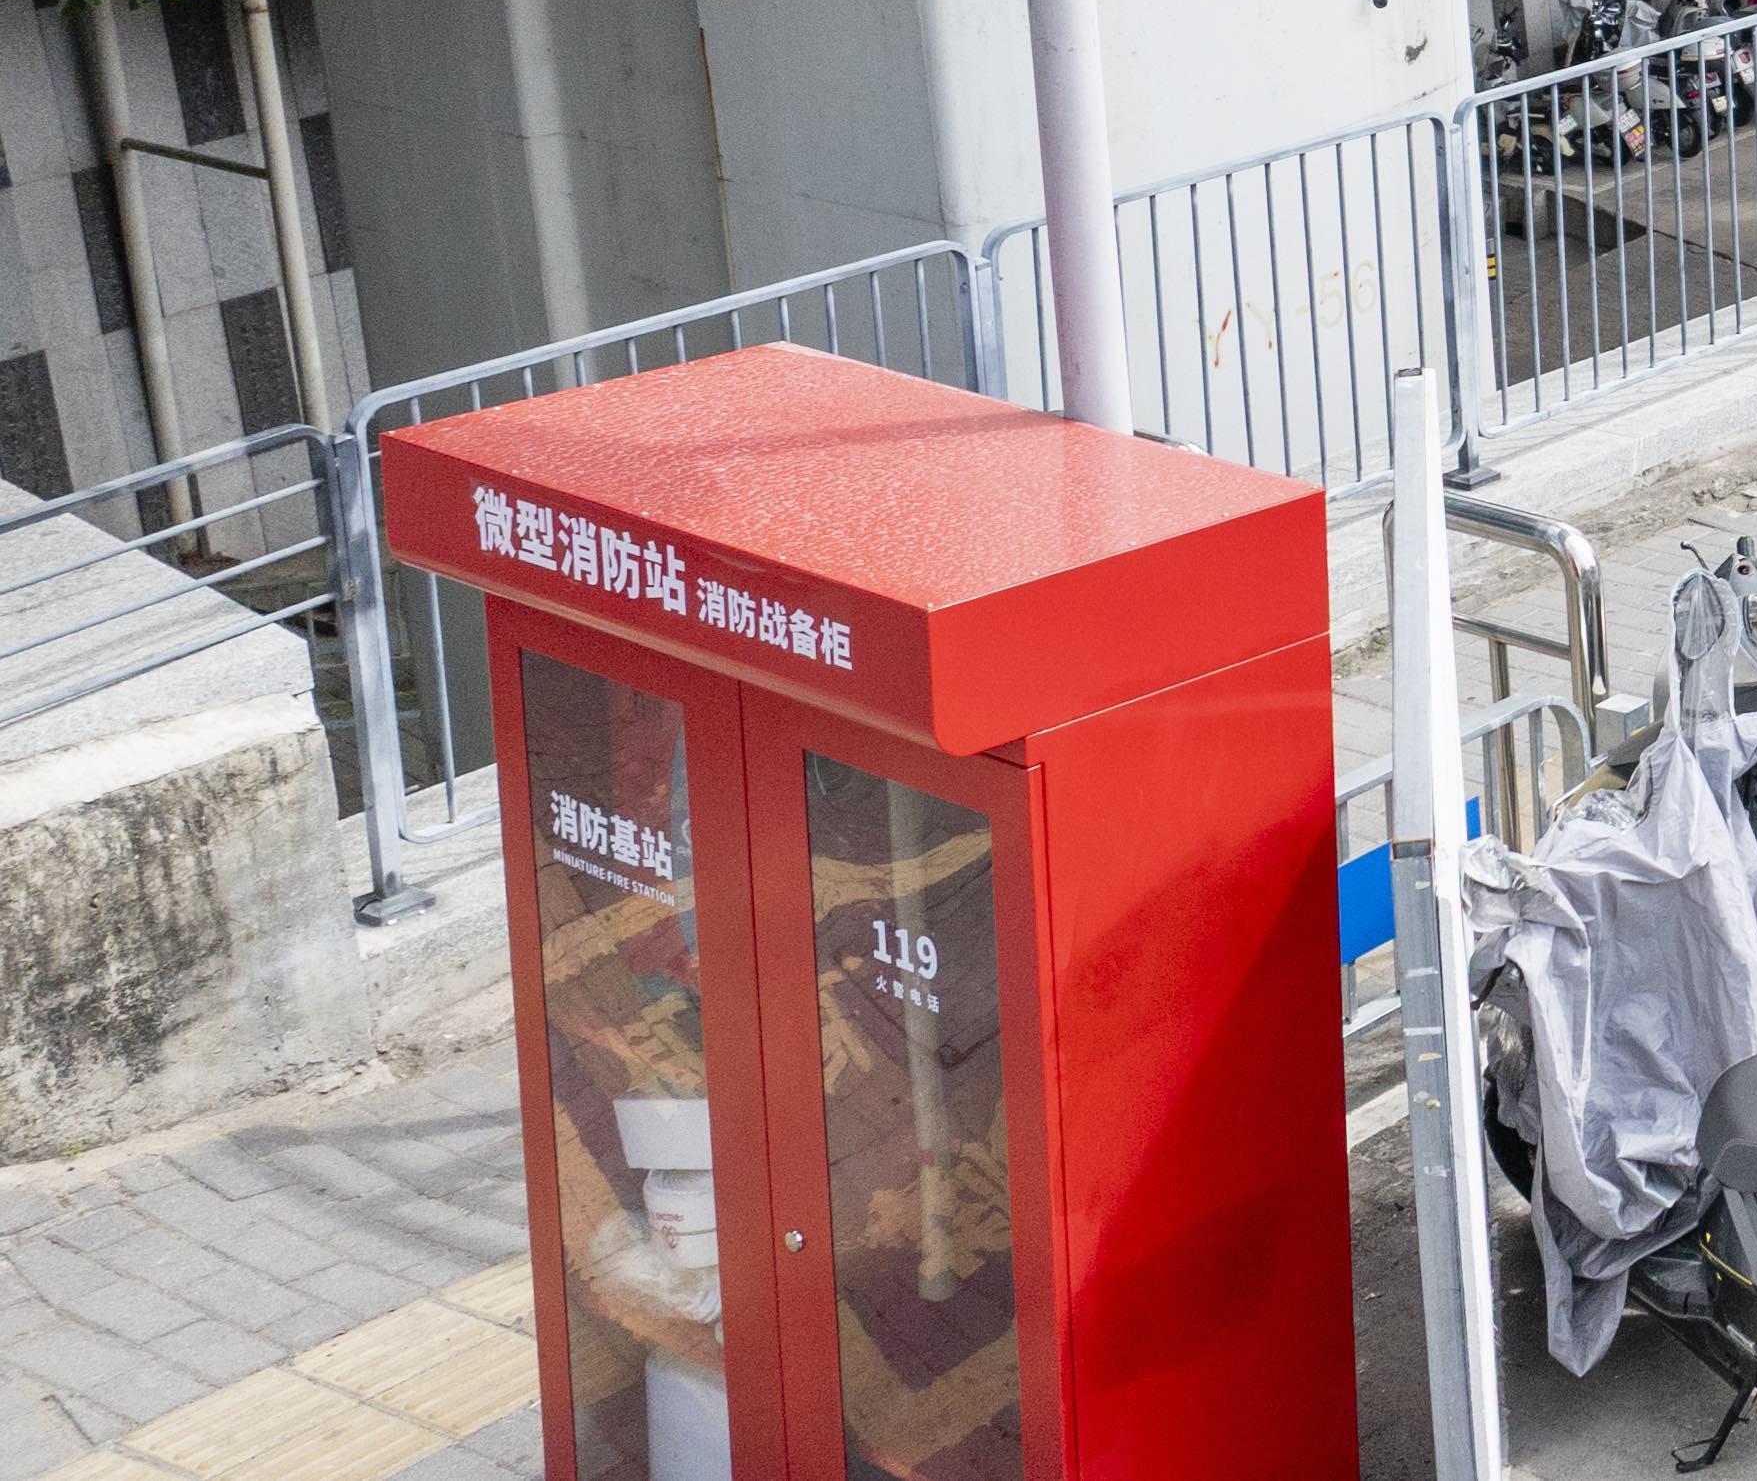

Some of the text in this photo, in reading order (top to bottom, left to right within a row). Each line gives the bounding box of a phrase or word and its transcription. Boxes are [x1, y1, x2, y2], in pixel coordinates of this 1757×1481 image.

[472, 485, 854, 671] 微型消防站 消防战备柜
[550, 790, 674, 882] 消防基站
[553, 847, 675, 907] MINIATURE FIRE STATION
[872, 919, 938, 980] 119
